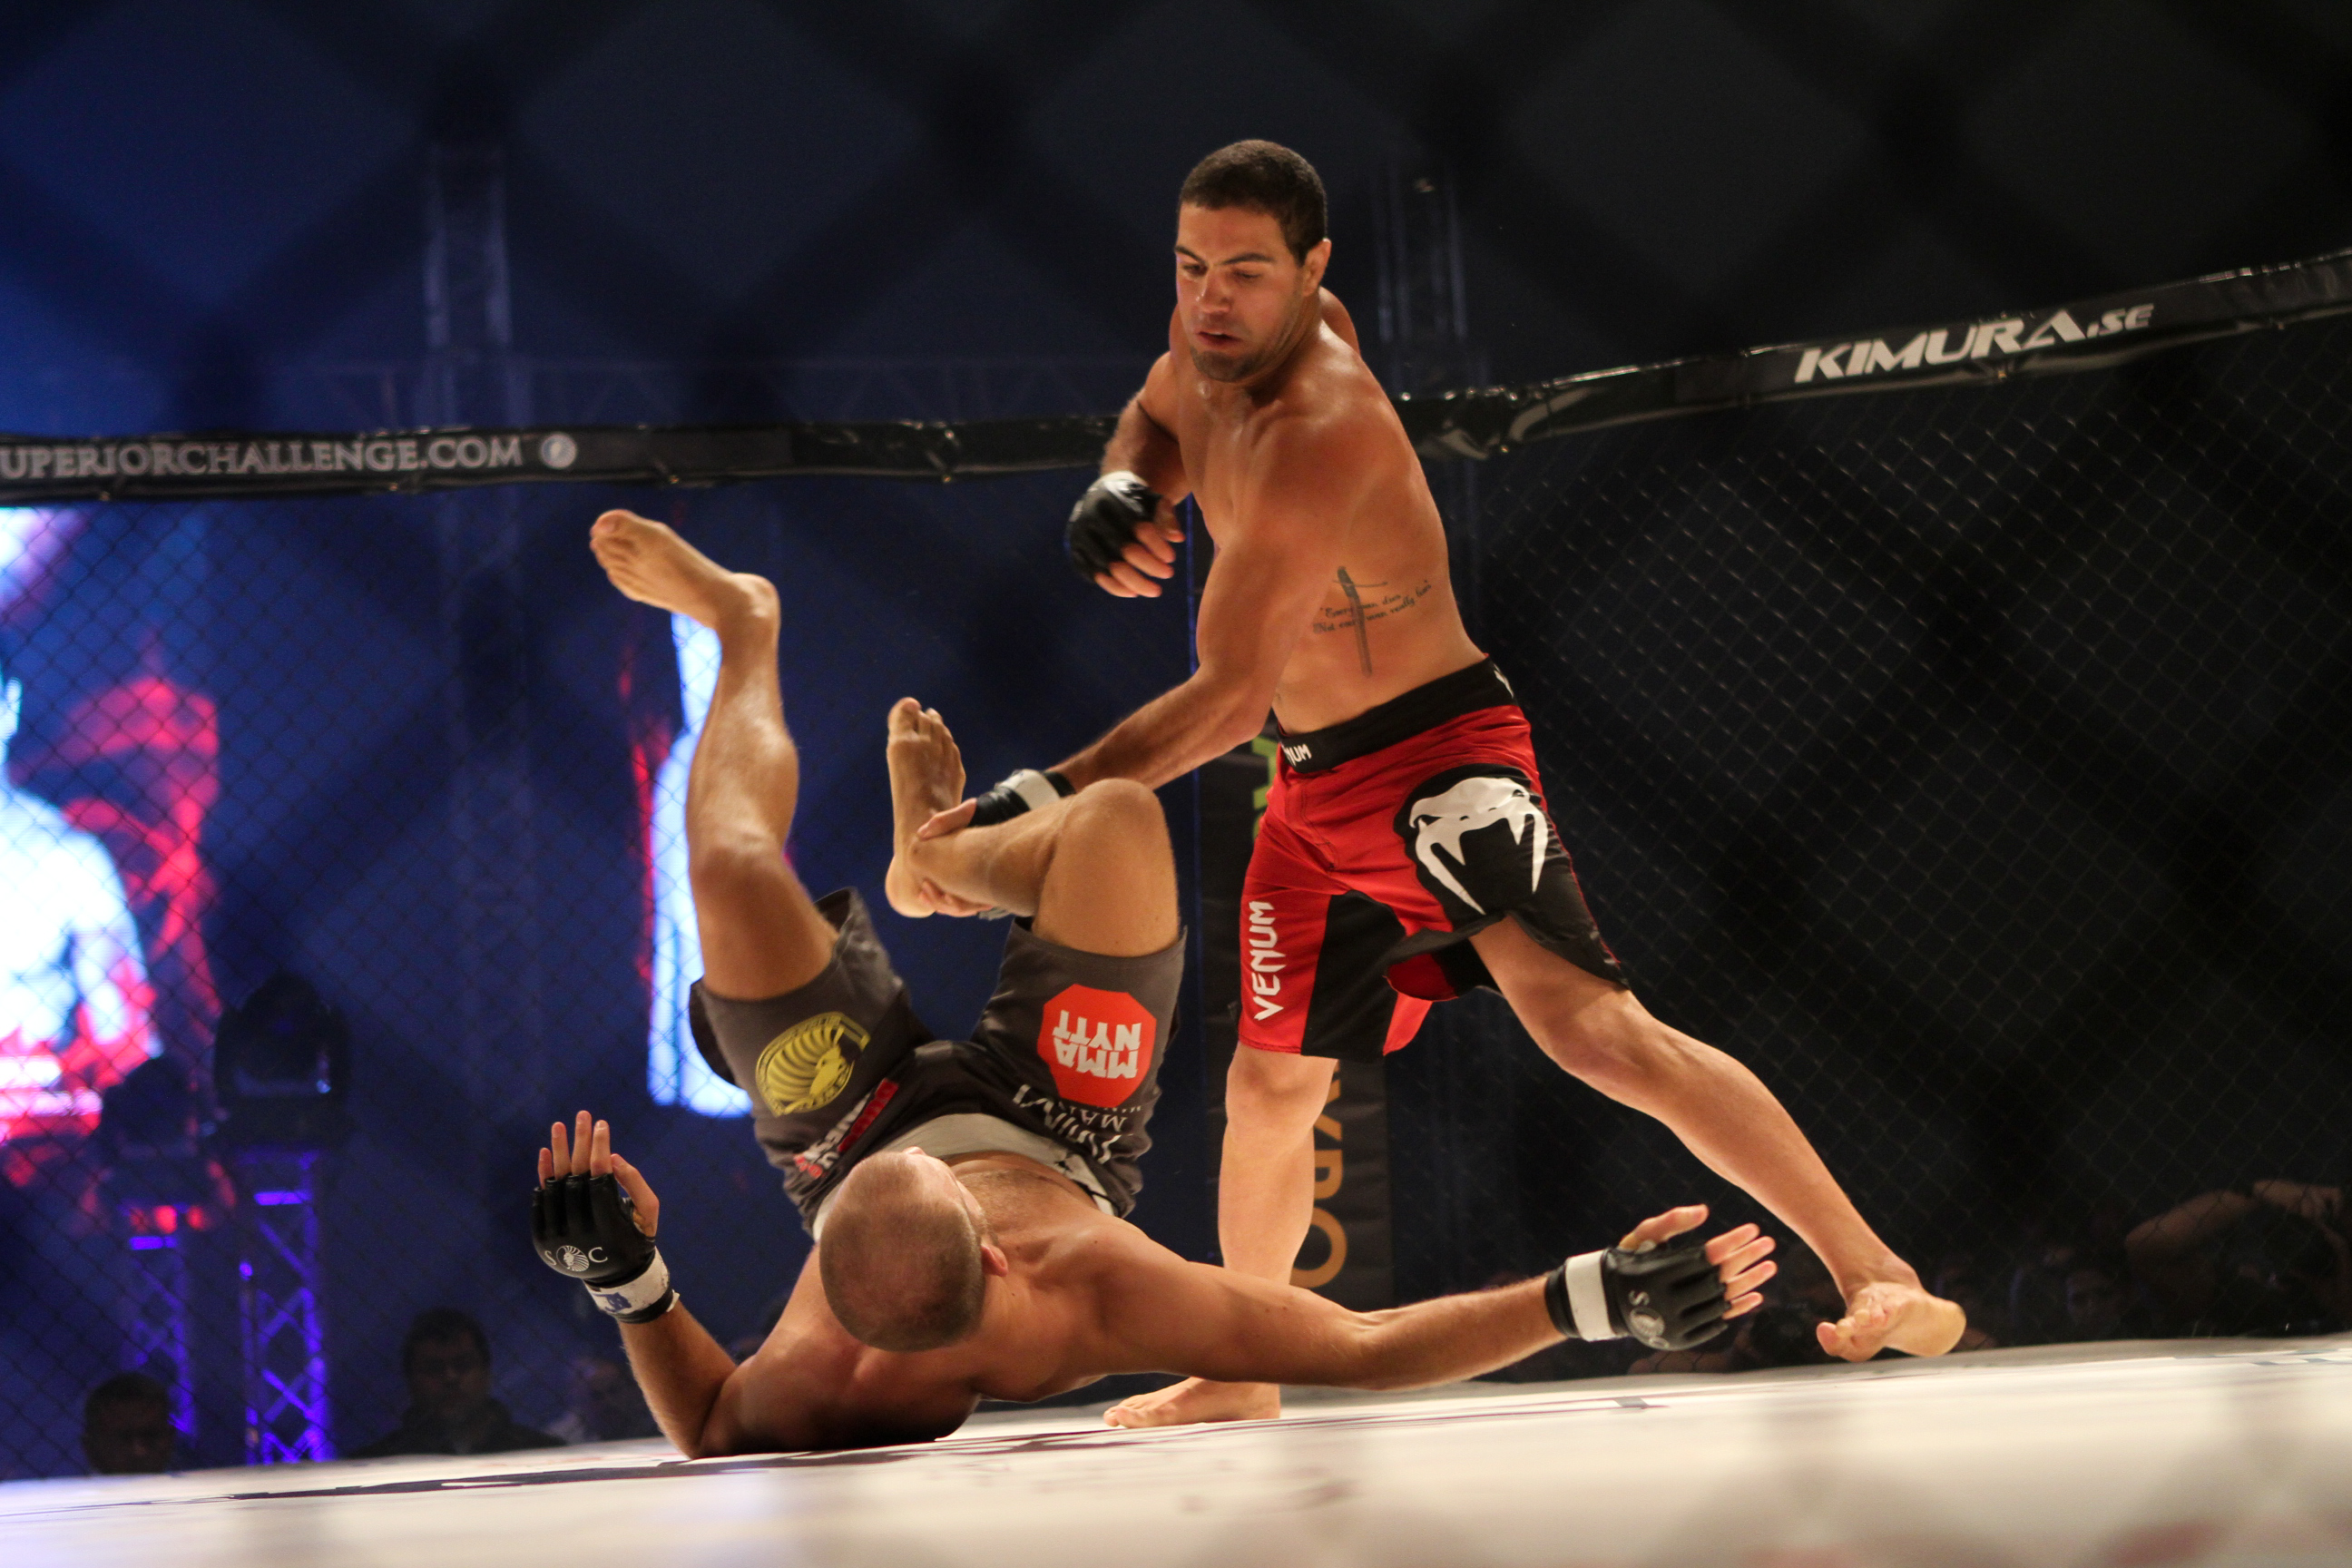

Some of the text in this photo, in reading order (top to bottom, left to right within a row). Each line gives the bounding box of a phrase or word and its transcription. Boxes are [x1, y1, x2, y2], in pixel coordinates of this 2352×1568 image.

[1247, 900, 1288, 1022] VENUM
[1051, 1009, 1142, 1052] NYTT
[1052, 1037, 1140, 1080] MMA
